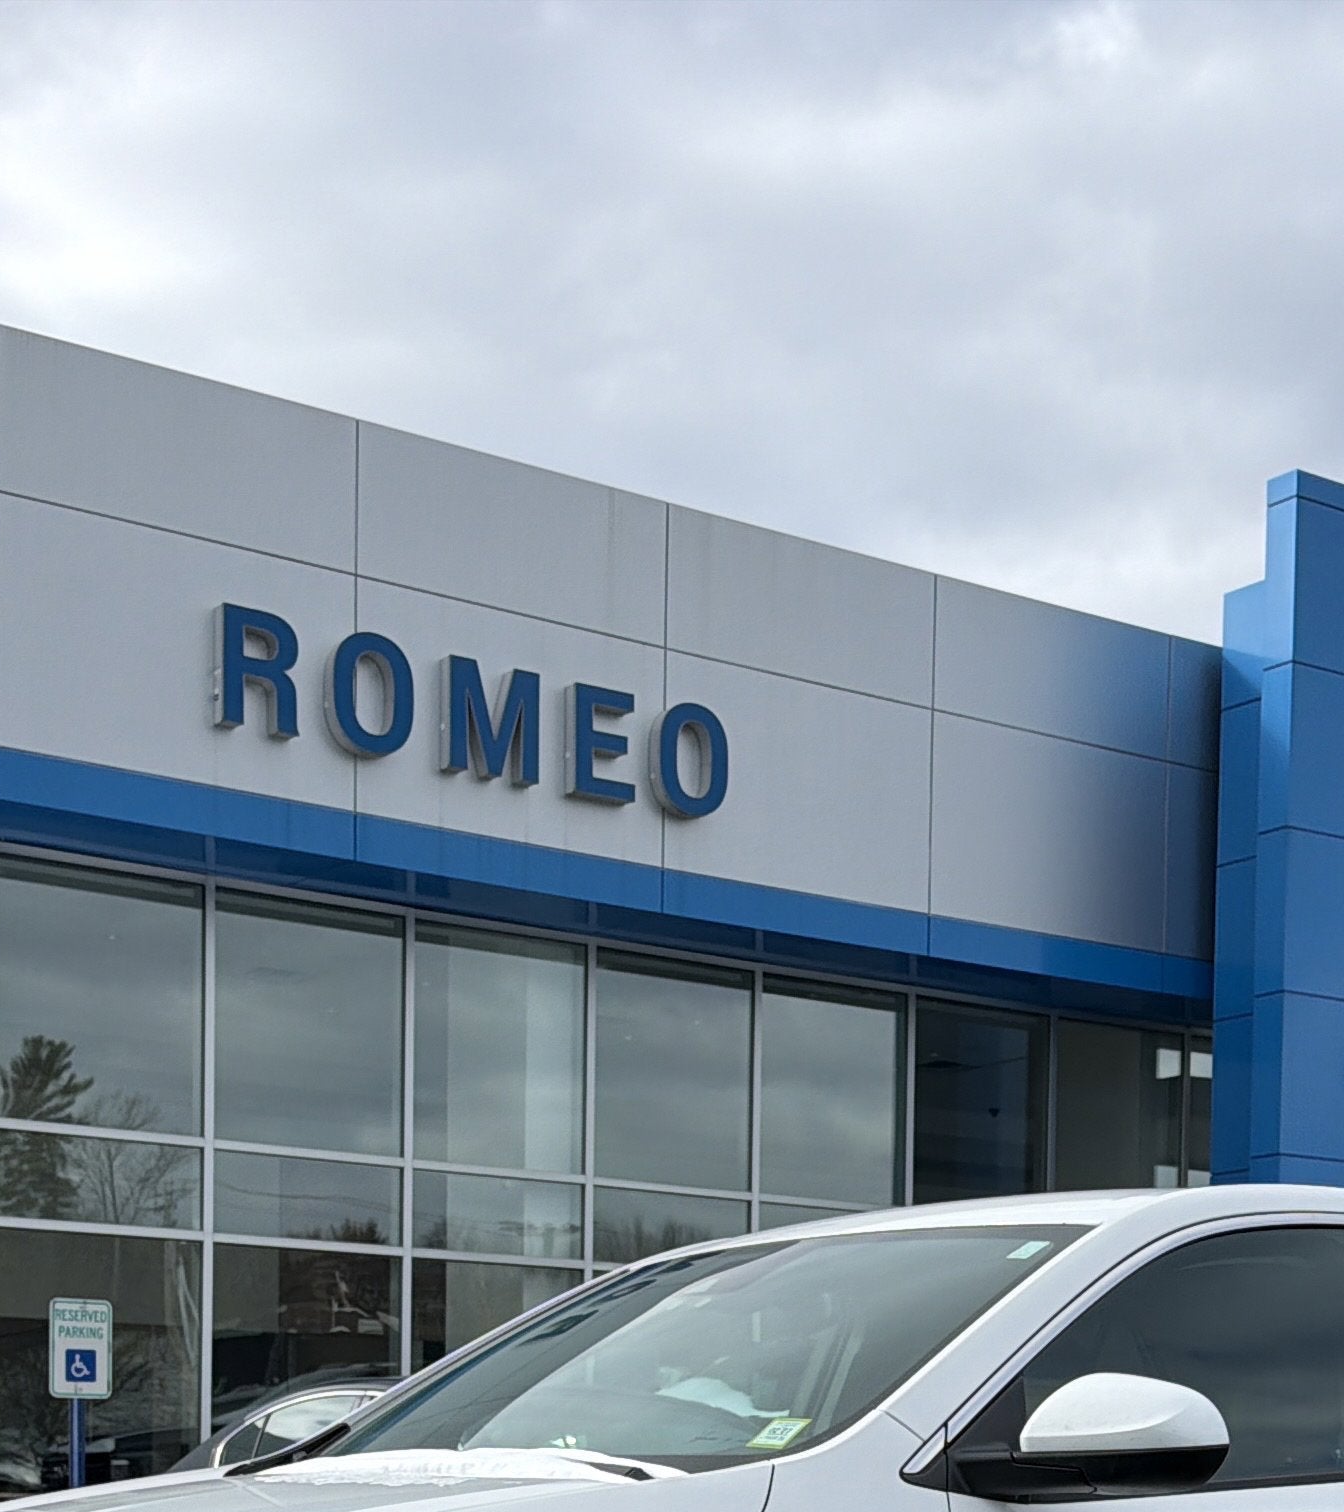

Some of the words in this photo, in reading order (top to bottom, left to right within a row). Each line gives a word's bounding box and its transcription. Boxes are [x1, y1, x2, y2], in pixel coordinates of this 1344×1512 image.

[214, 602, 729, 819] ROMEO
[54, 1309, 107, 1323] RESERVED
[58, 1325, 104, 1340] PARKING
